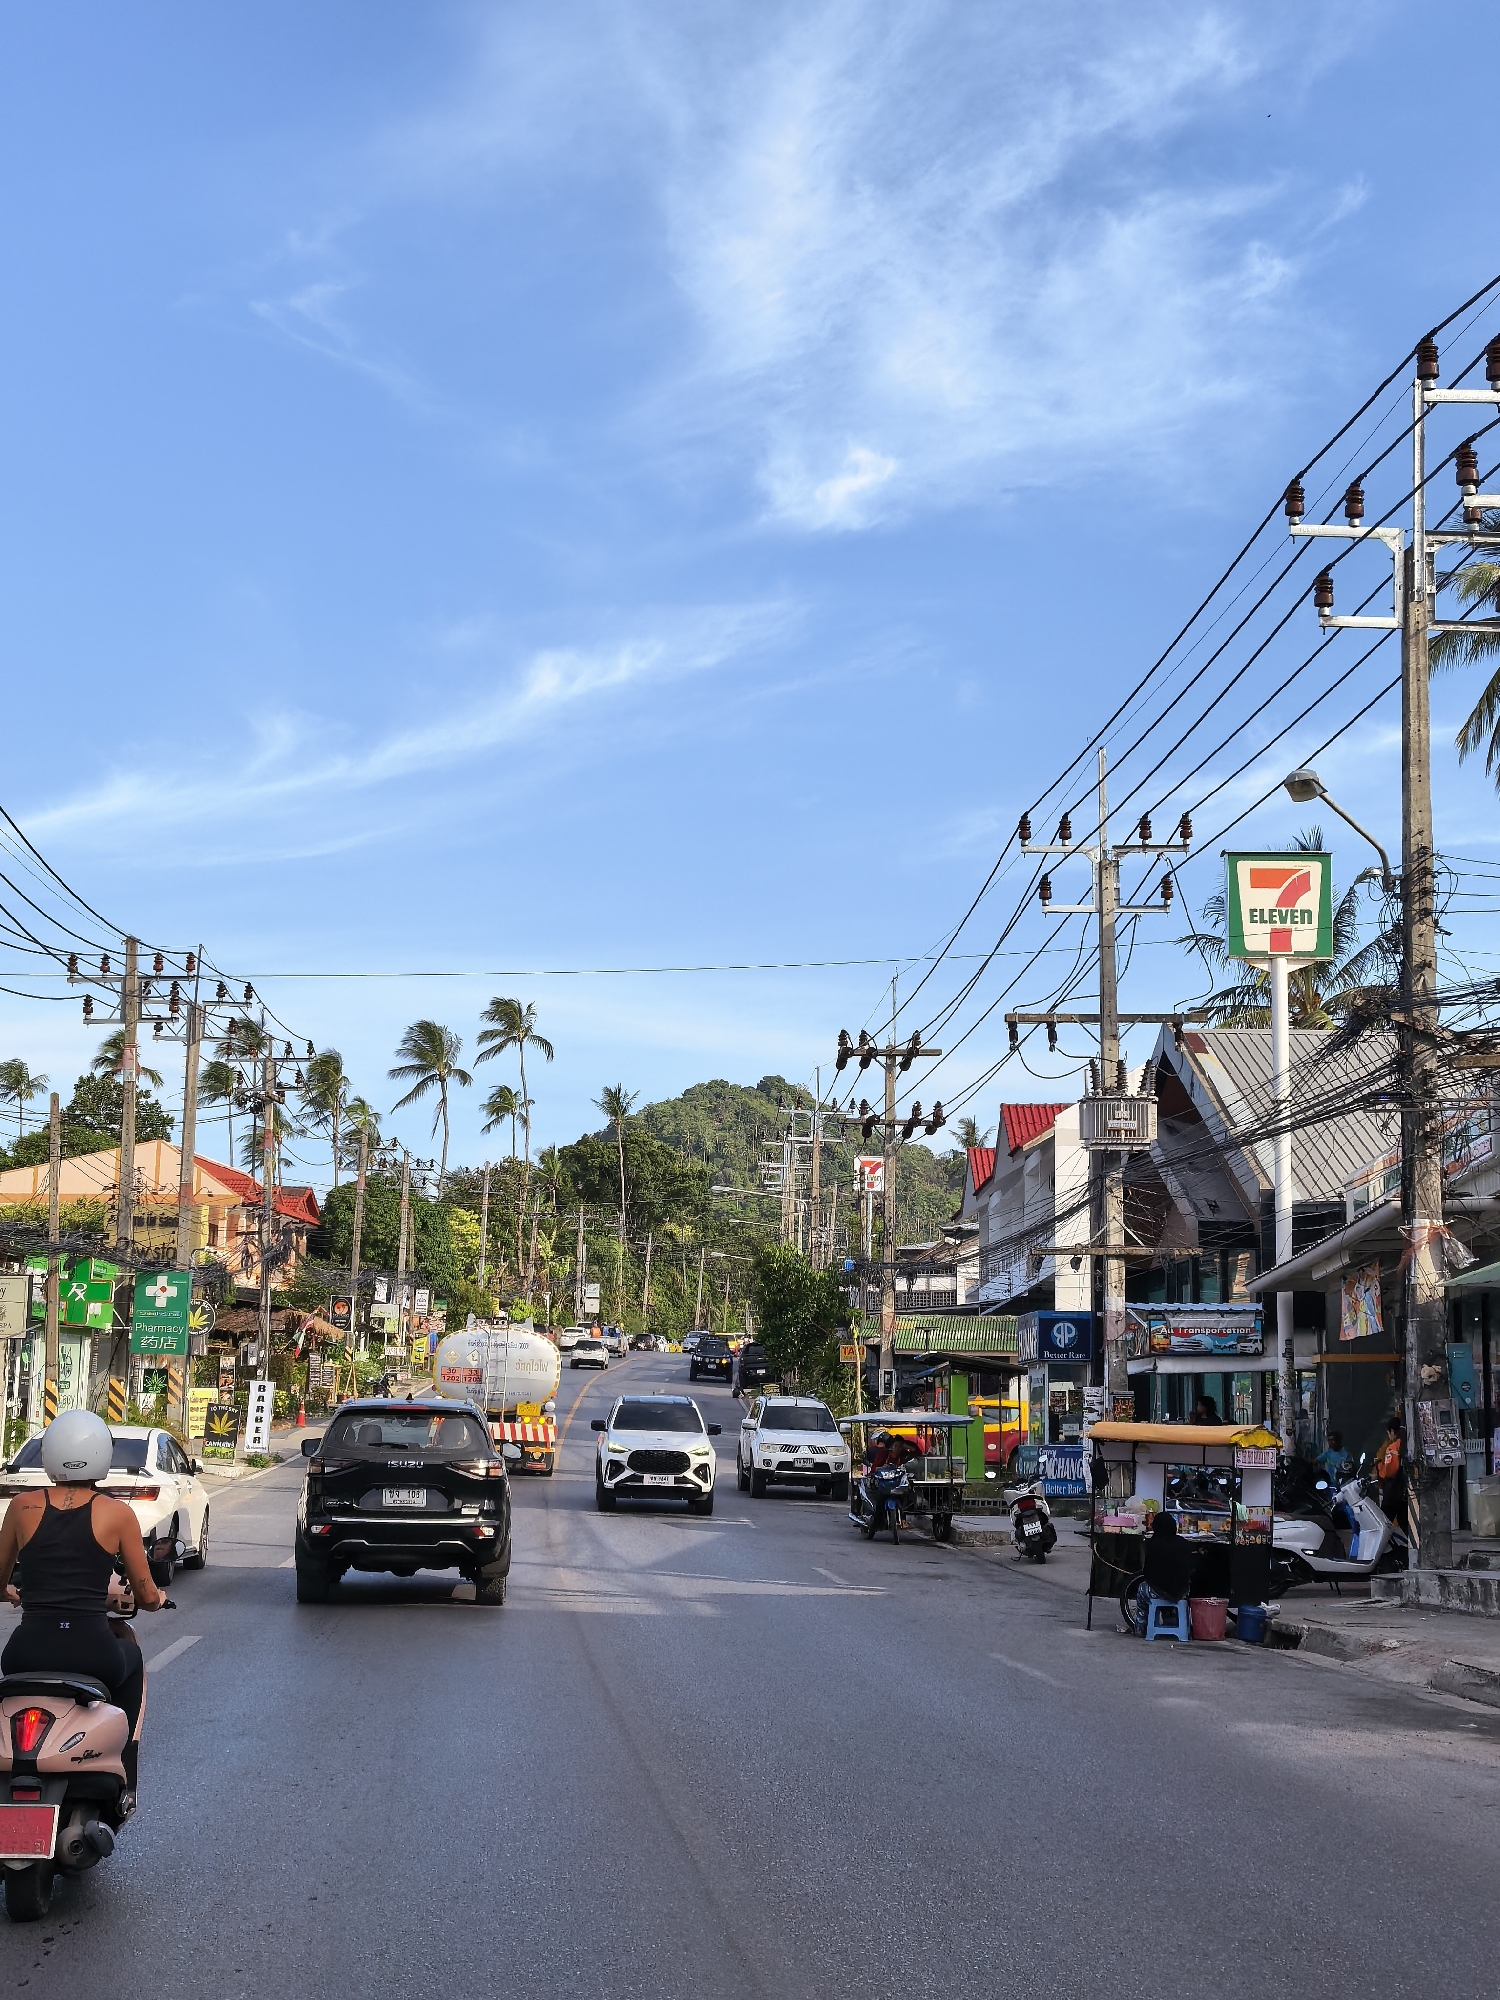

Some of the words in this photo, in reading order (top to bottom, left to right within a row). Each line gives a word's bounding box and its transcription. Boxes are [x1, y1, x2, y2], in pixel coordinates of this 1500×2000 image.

[1250, 868, 1311, 953] 7
[135, 1322, 184, 1335] Pharmacy
[140, 1336, 178, 1349] 药店
[1043, 1350, 1067, 1358] Better
[252, 1384, 267, 1444] BARBER
[387, 1460, 424, 1468] ISUZU
[1045, 1483, 1066, 1495] Better
[1067, 1483, 1084, 1495] Rate
